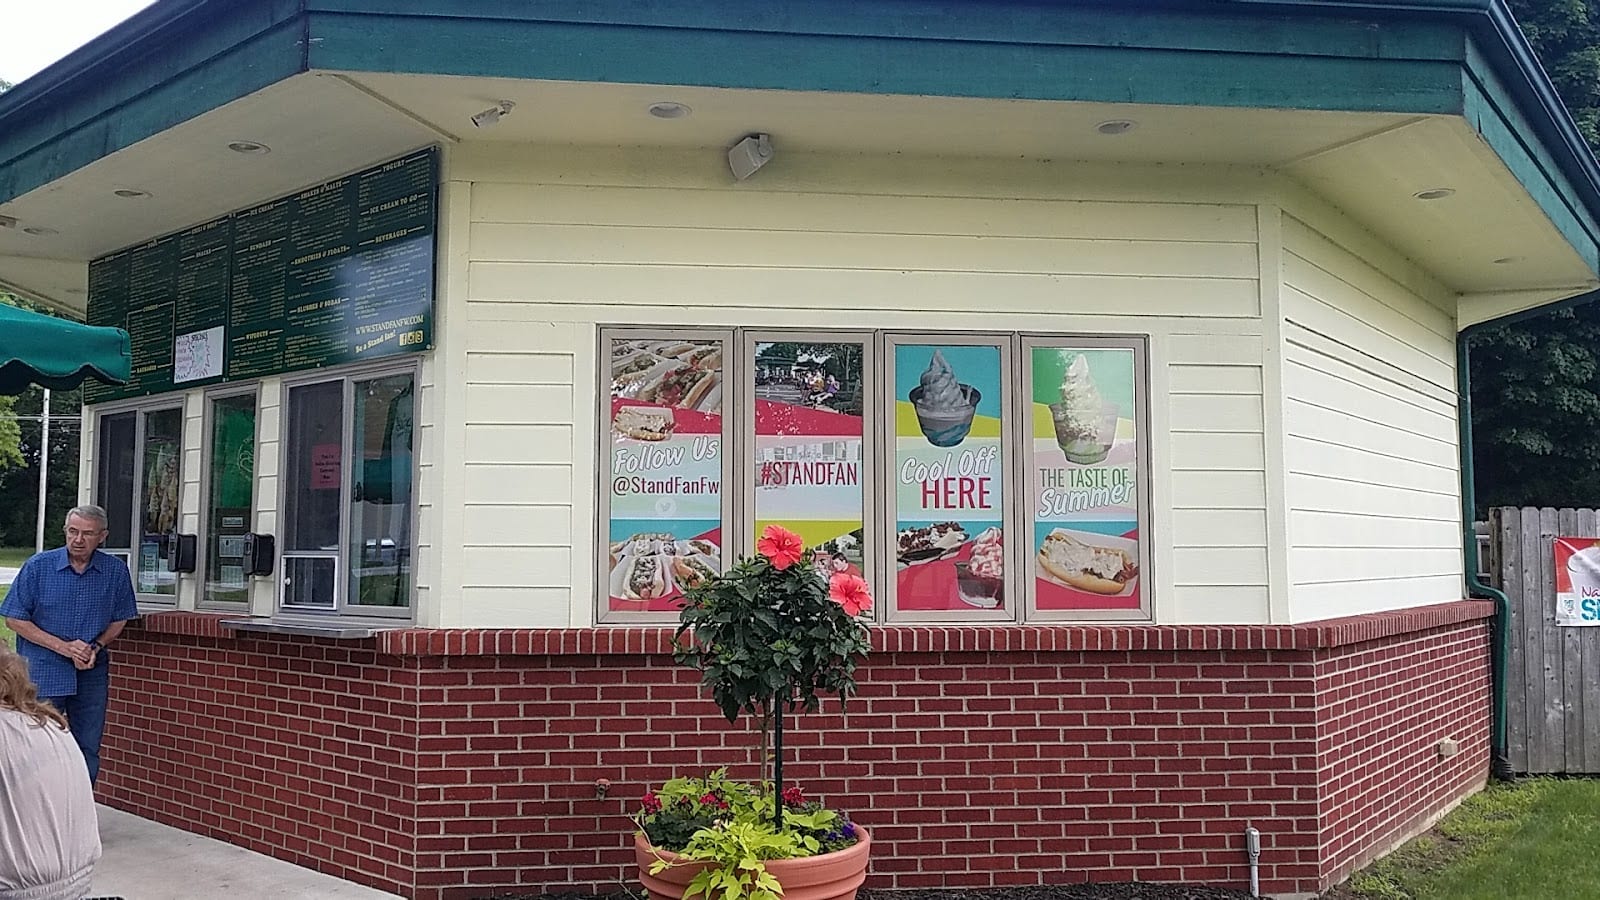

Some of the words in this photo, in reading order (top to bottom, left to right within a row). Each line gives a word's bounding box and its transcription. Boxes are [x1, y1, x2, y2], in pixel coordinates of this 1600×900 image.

[375, 229, 407, 243] BEVERAGES
[367, 335, 384, 348] Stand
[613, 445, 686, 475] Follow
[692, 436, 719, 461] Us
[901, 452, 953, 484] Cool
[958, 445, 998, 476] Off
[761, 462, 857, 485] #STANDFAN
[1040, 468, 1064, 487] THE
[1068, 468, 1107, 487] TASTE
[1112, 468, 1129, 487] OF
[613, 476, 720, 496] @StandFanFw
[922, 477, 992, 509] HERE
[1039, 481, 1136, 518] Summer
[1581, 599, 1600, 620] S
